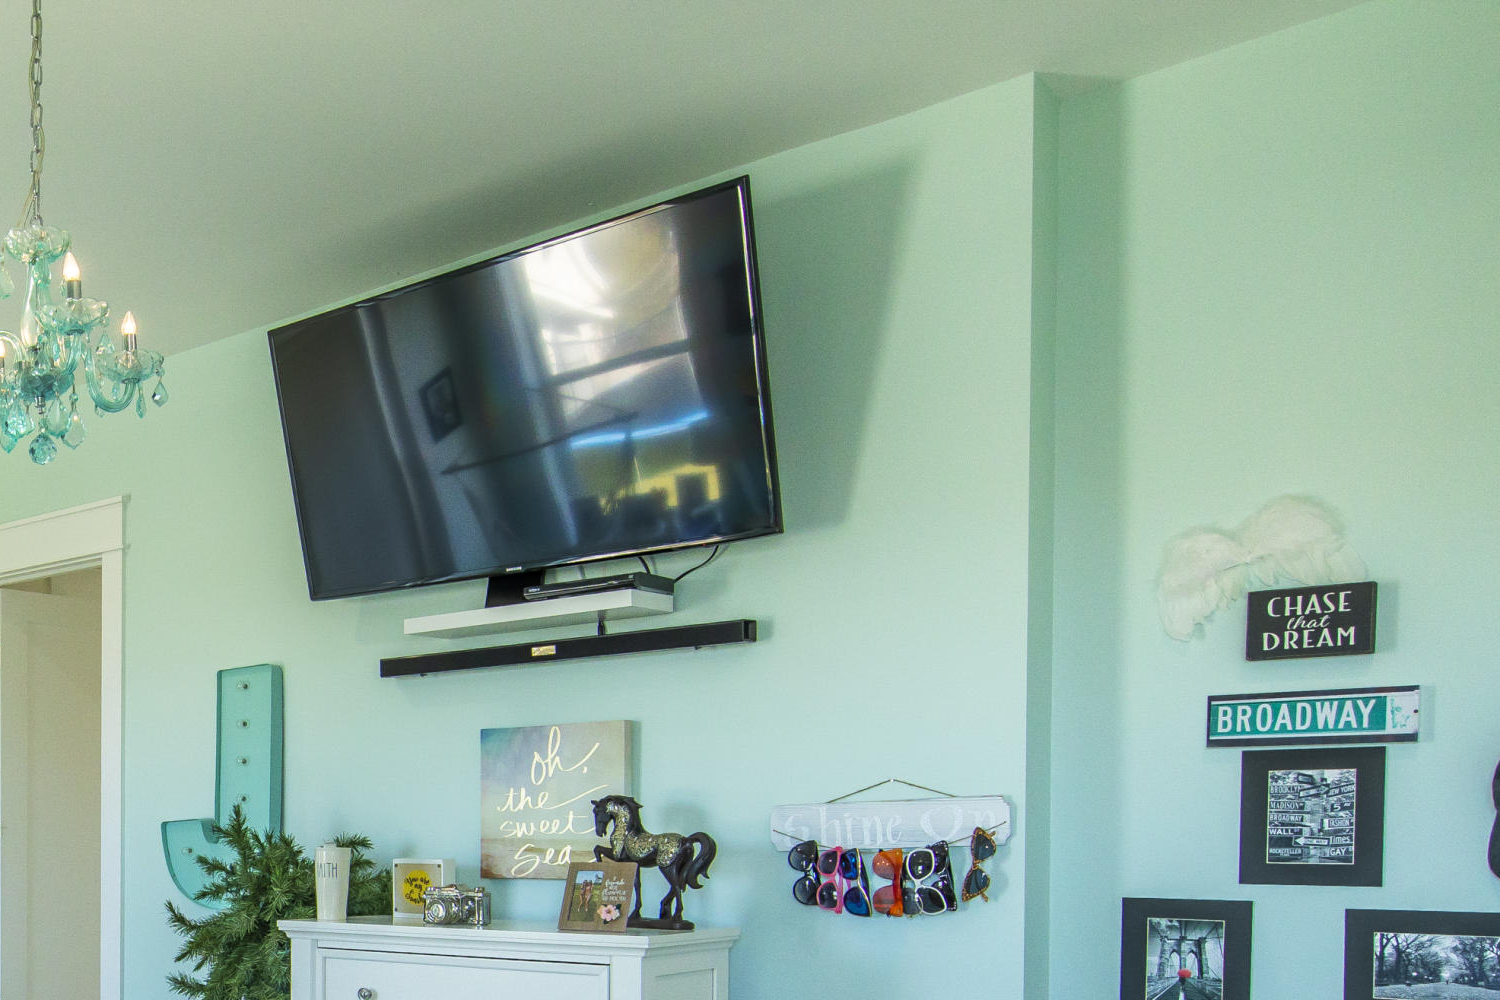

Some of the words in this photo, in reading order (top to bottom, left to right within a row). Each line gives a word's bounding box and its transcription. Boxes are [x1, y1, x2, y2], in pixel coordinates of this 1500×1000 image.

[1267, 590, 1352, 617] CHASE
[1286, 614, 1331, 630] that
[1262, 626, 1356, 651] DREAM
[1217, 699, 1376, 733] BROADWAY
[496, 784, 610, 812] the
[1270, 801, 1299, 809] MADISON
[1334, 803, 1341, 811] 5
[500, 810, 596, 838] sweet
[1330, 848, 1346, 856] GAY
